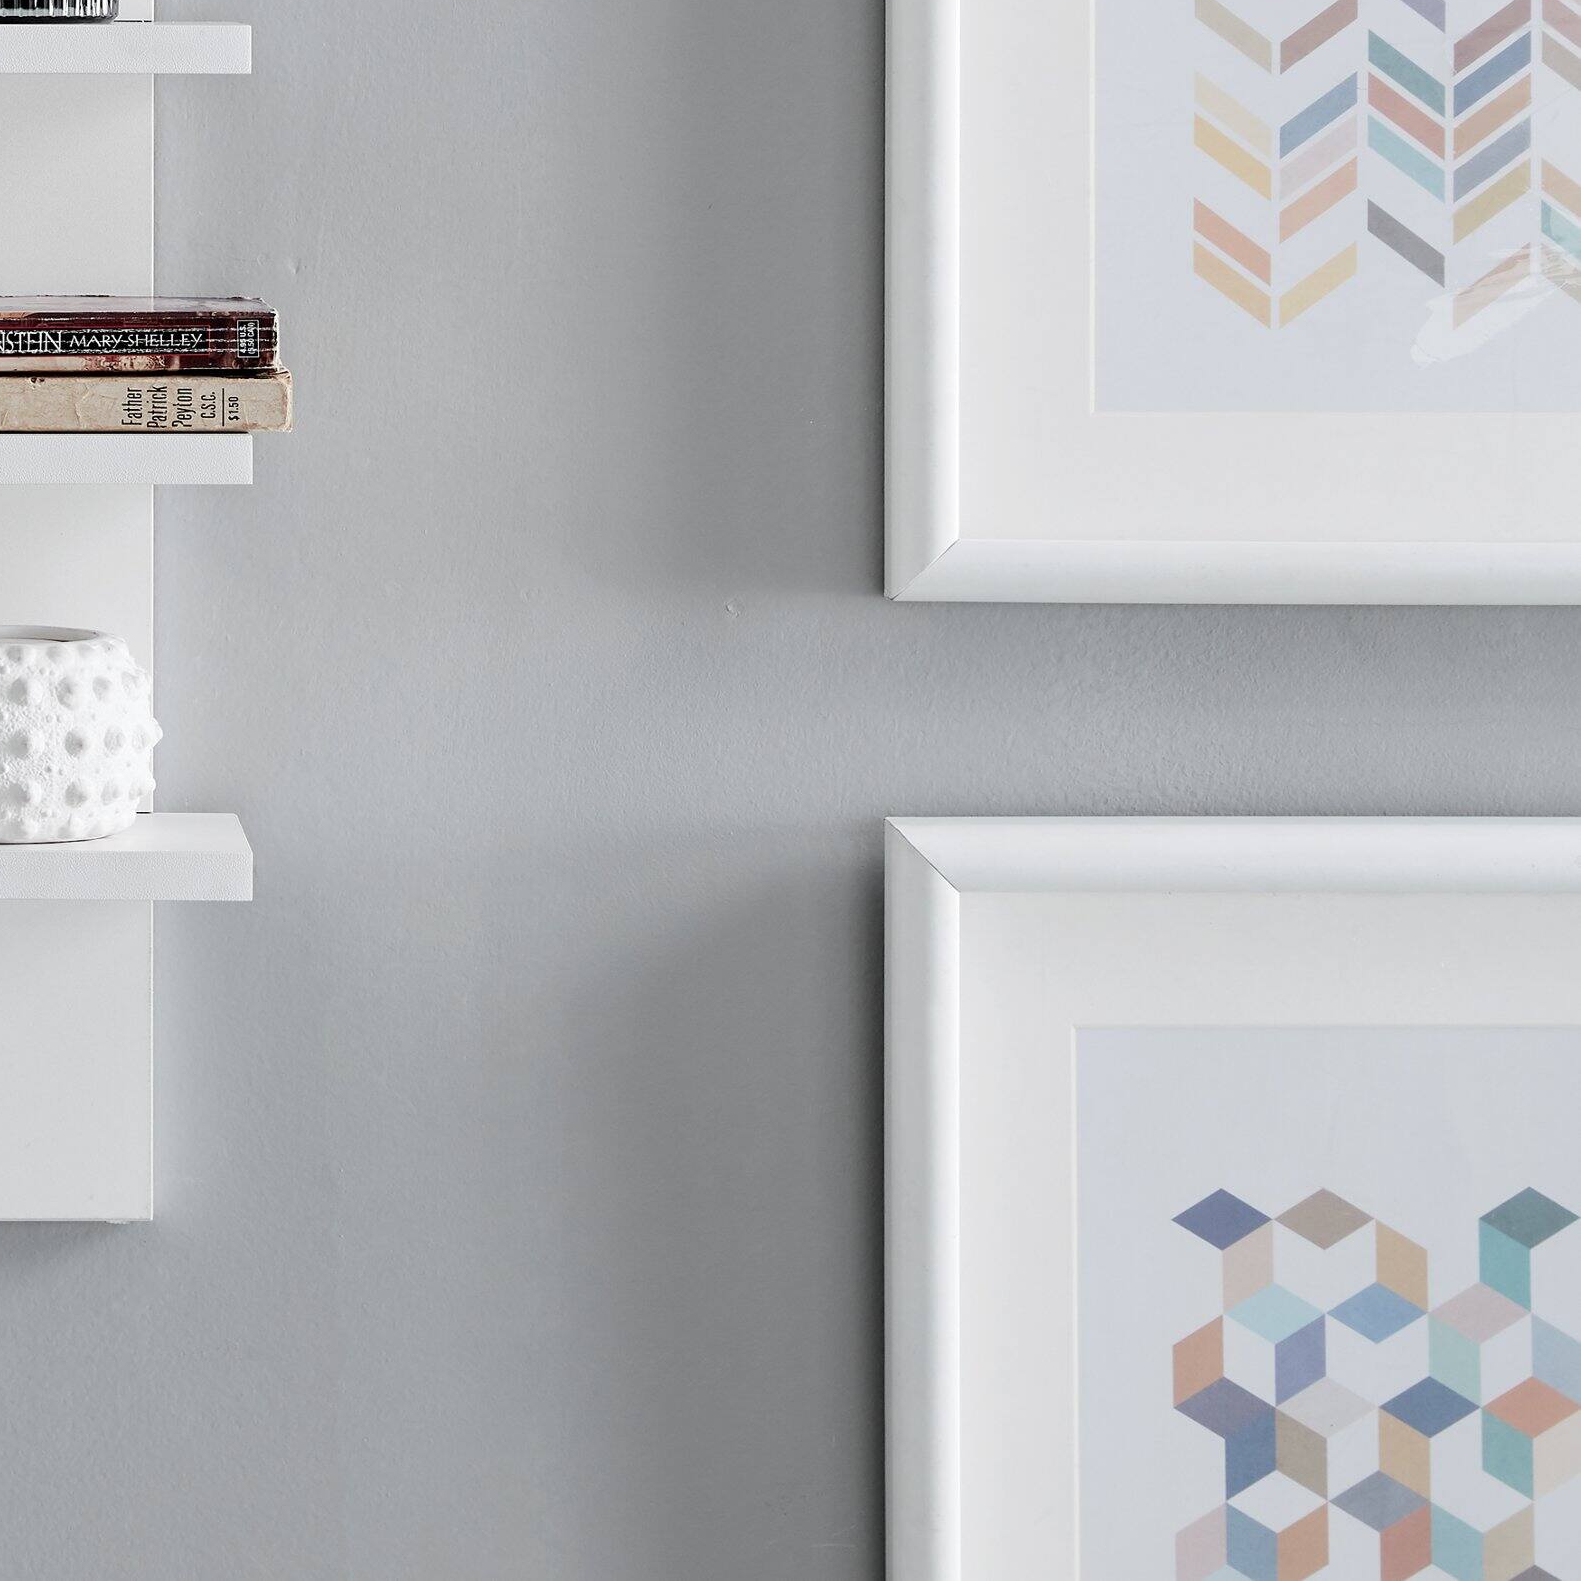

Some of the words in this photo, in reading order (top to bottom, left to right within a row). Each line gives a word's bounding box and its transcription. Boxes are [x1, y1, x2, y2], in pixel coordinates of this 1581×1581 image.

[69, 334, 123, 349] MARY
[127, 333, 203, 348] SHELLEY
[239, 324, 247, 337] U.S.
[121, 387, 143, 426] Father
[146, 385, 168, 429] Patrick
[172, 387, 197, 428] Peyton
[200, 391, 217, 419] C.S.C.
[228, 396, 240, 421] $1.50
